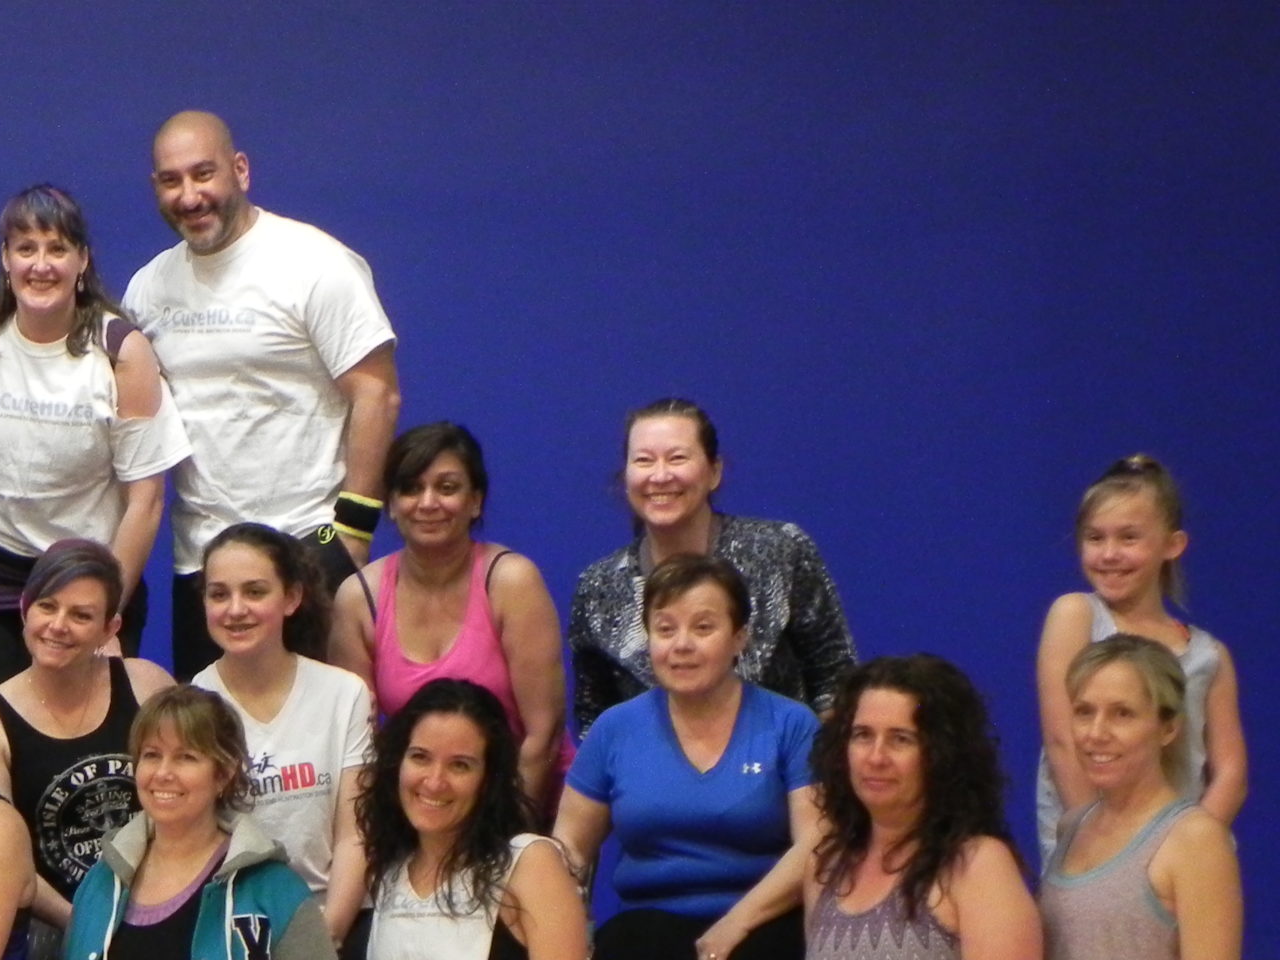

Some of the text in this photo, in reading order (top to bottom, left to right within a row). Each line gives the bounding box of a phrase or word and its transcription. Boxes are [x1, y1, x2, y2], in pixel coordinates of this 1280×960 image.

[172, 309, 256, 326] CureHD.ca
[0, 393, 94, 419] CureHD.ca
[42, 787, 69, 828] ISLE
[70, 763, 97, 786] OF
[107, 759, 135, 777] PA
[73, 837, 102, 857] OFF
